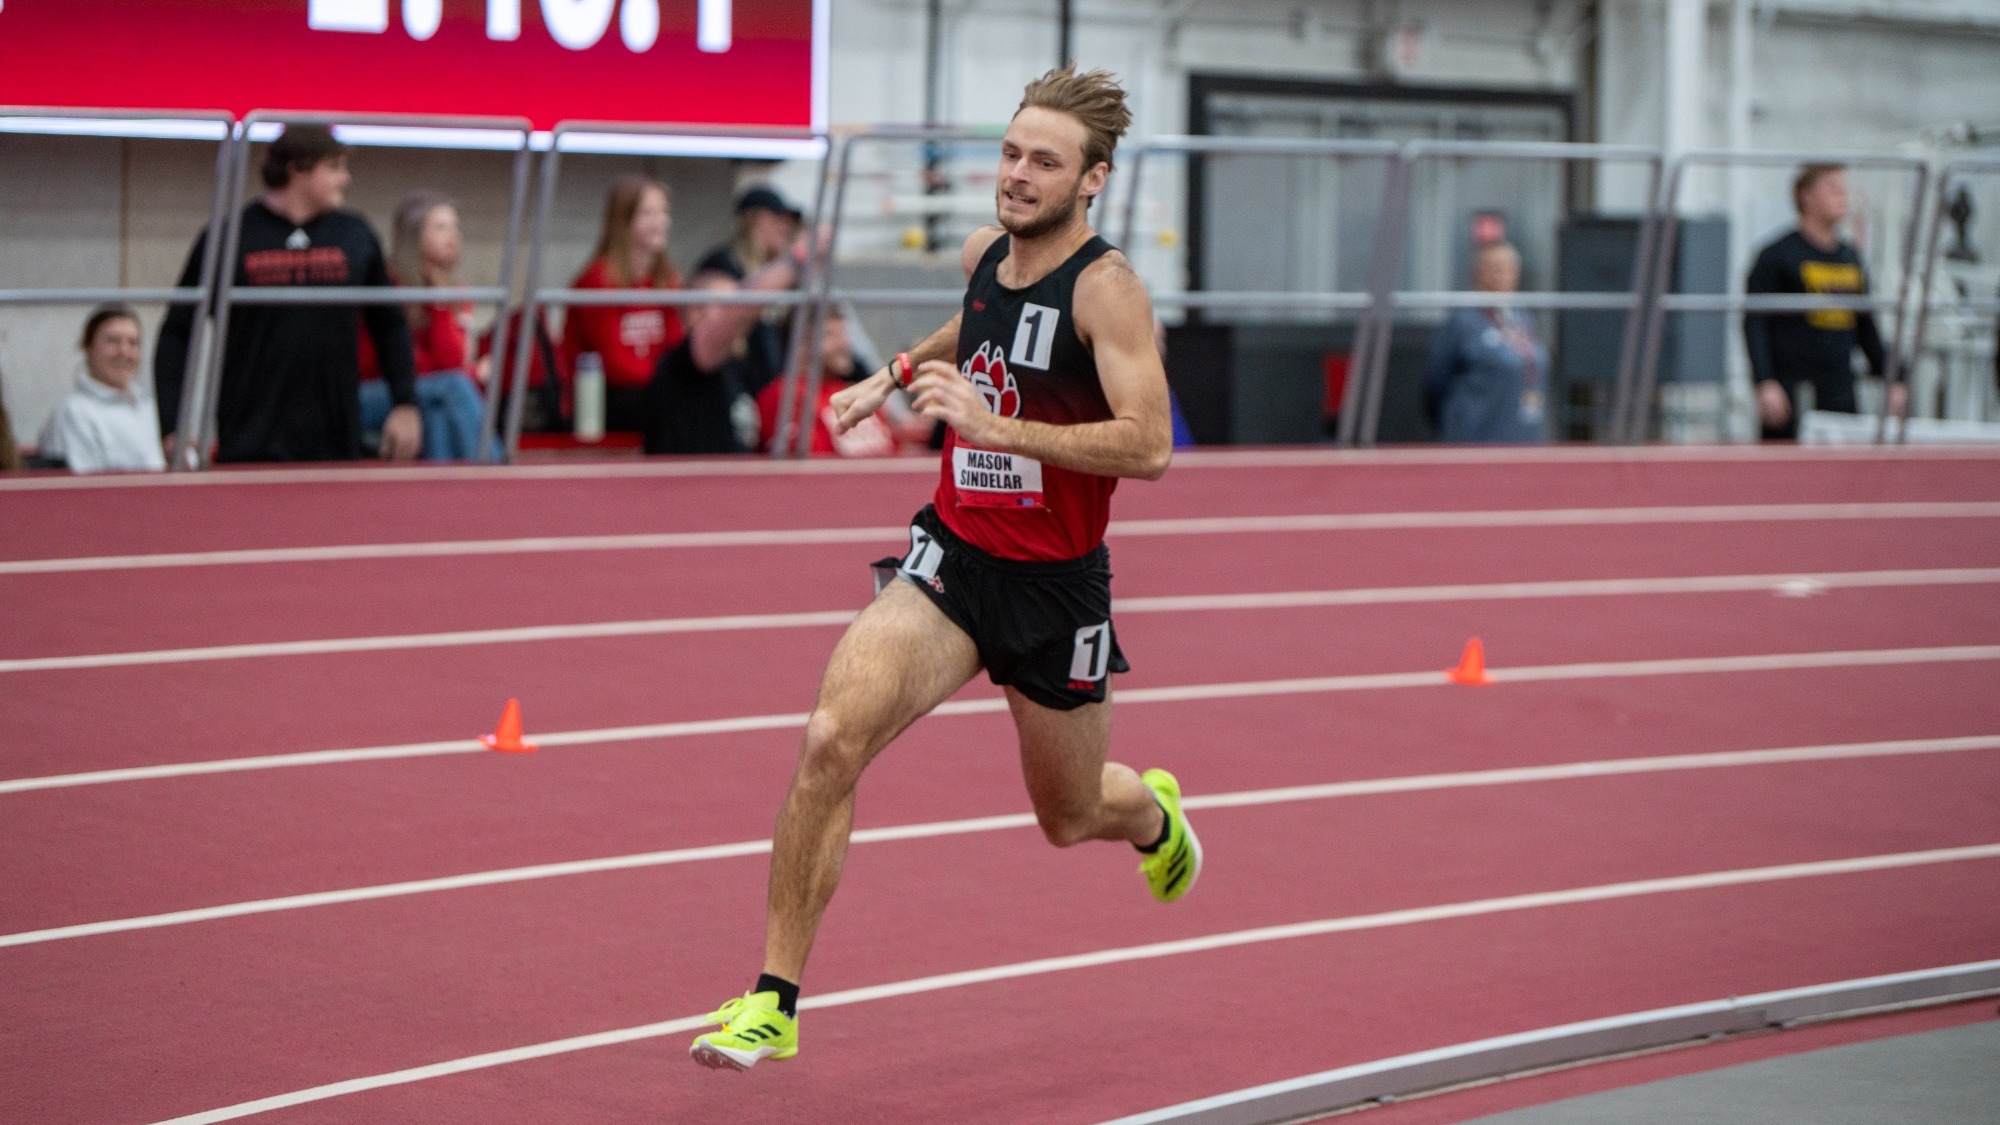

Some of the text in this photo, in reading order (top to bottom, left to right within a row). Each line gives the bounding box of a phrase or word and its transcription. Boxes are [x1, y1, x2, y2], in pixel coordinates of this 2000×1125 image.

[1024, 309, 1043, 363] 1
[960, 468, 1023, 490] SINDELAR
[967, 451, 1012, 471] MASON
[910, 533, 934, 570] 1
[1083, 629, 1102, 677] 1
